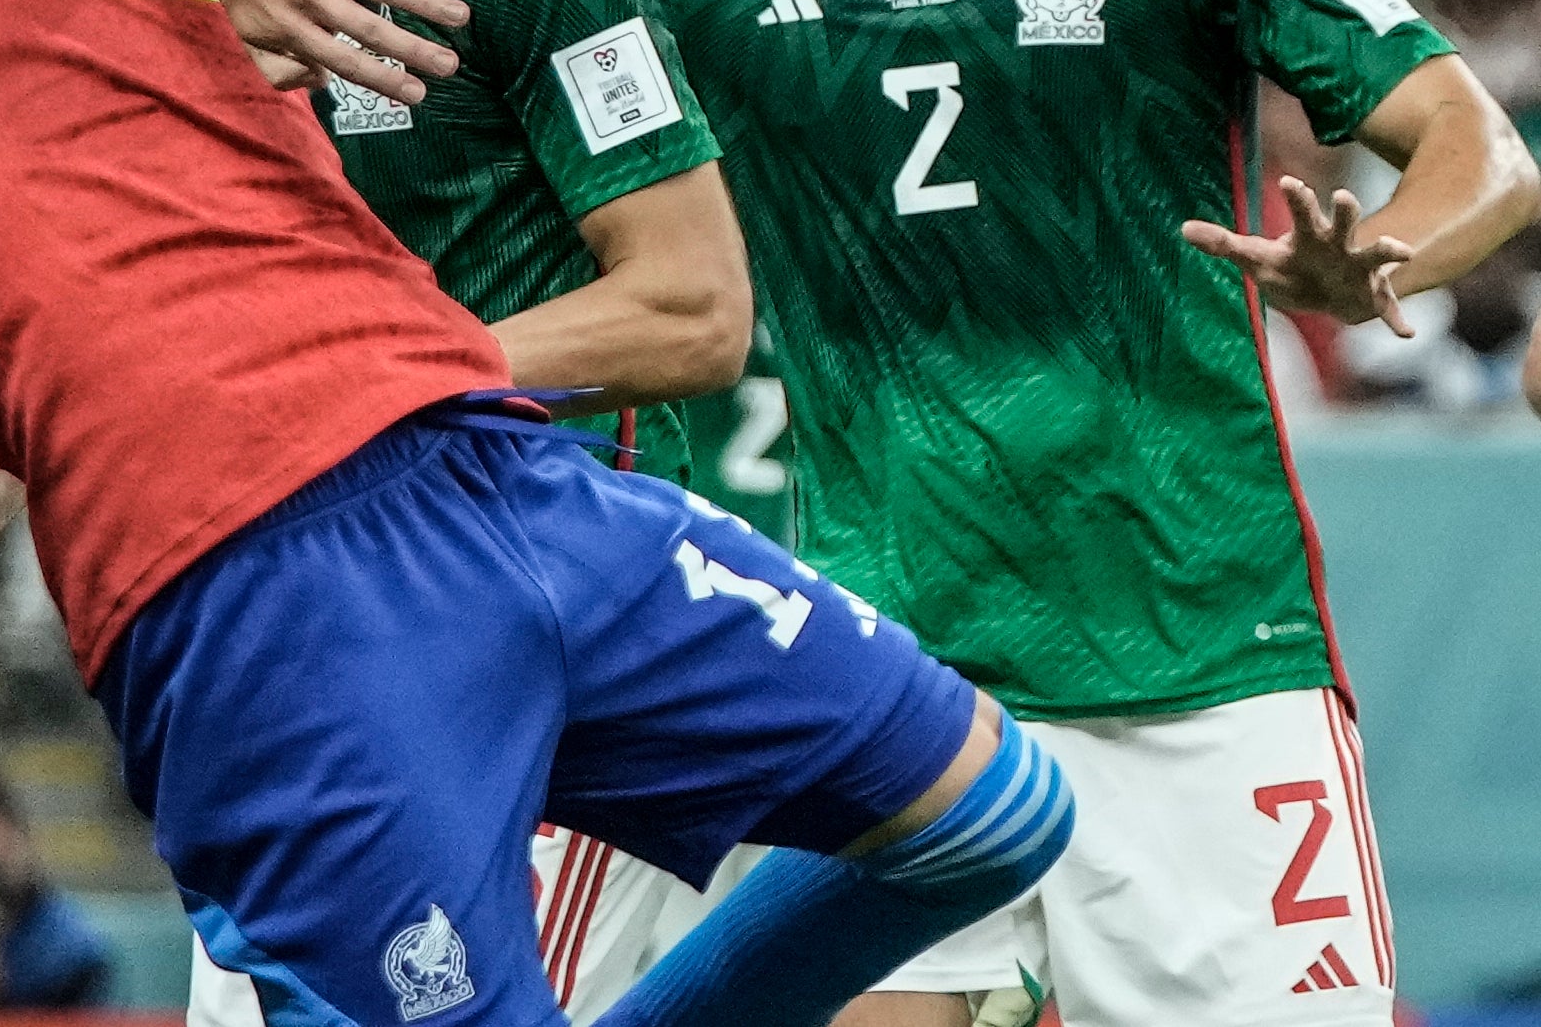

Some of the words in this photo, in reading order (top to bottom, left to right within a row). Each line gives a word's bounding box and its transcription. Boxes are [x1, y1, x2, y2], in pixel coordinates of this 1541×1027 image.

[1021, 21, 1103, 41] MÉXICO
[602, 80, 640, 104] UNITES
[337, 108, 410, 132] MÉXICO
[881, 61, 979, 216] 2
[1253, 779, 1352, 927] 2
